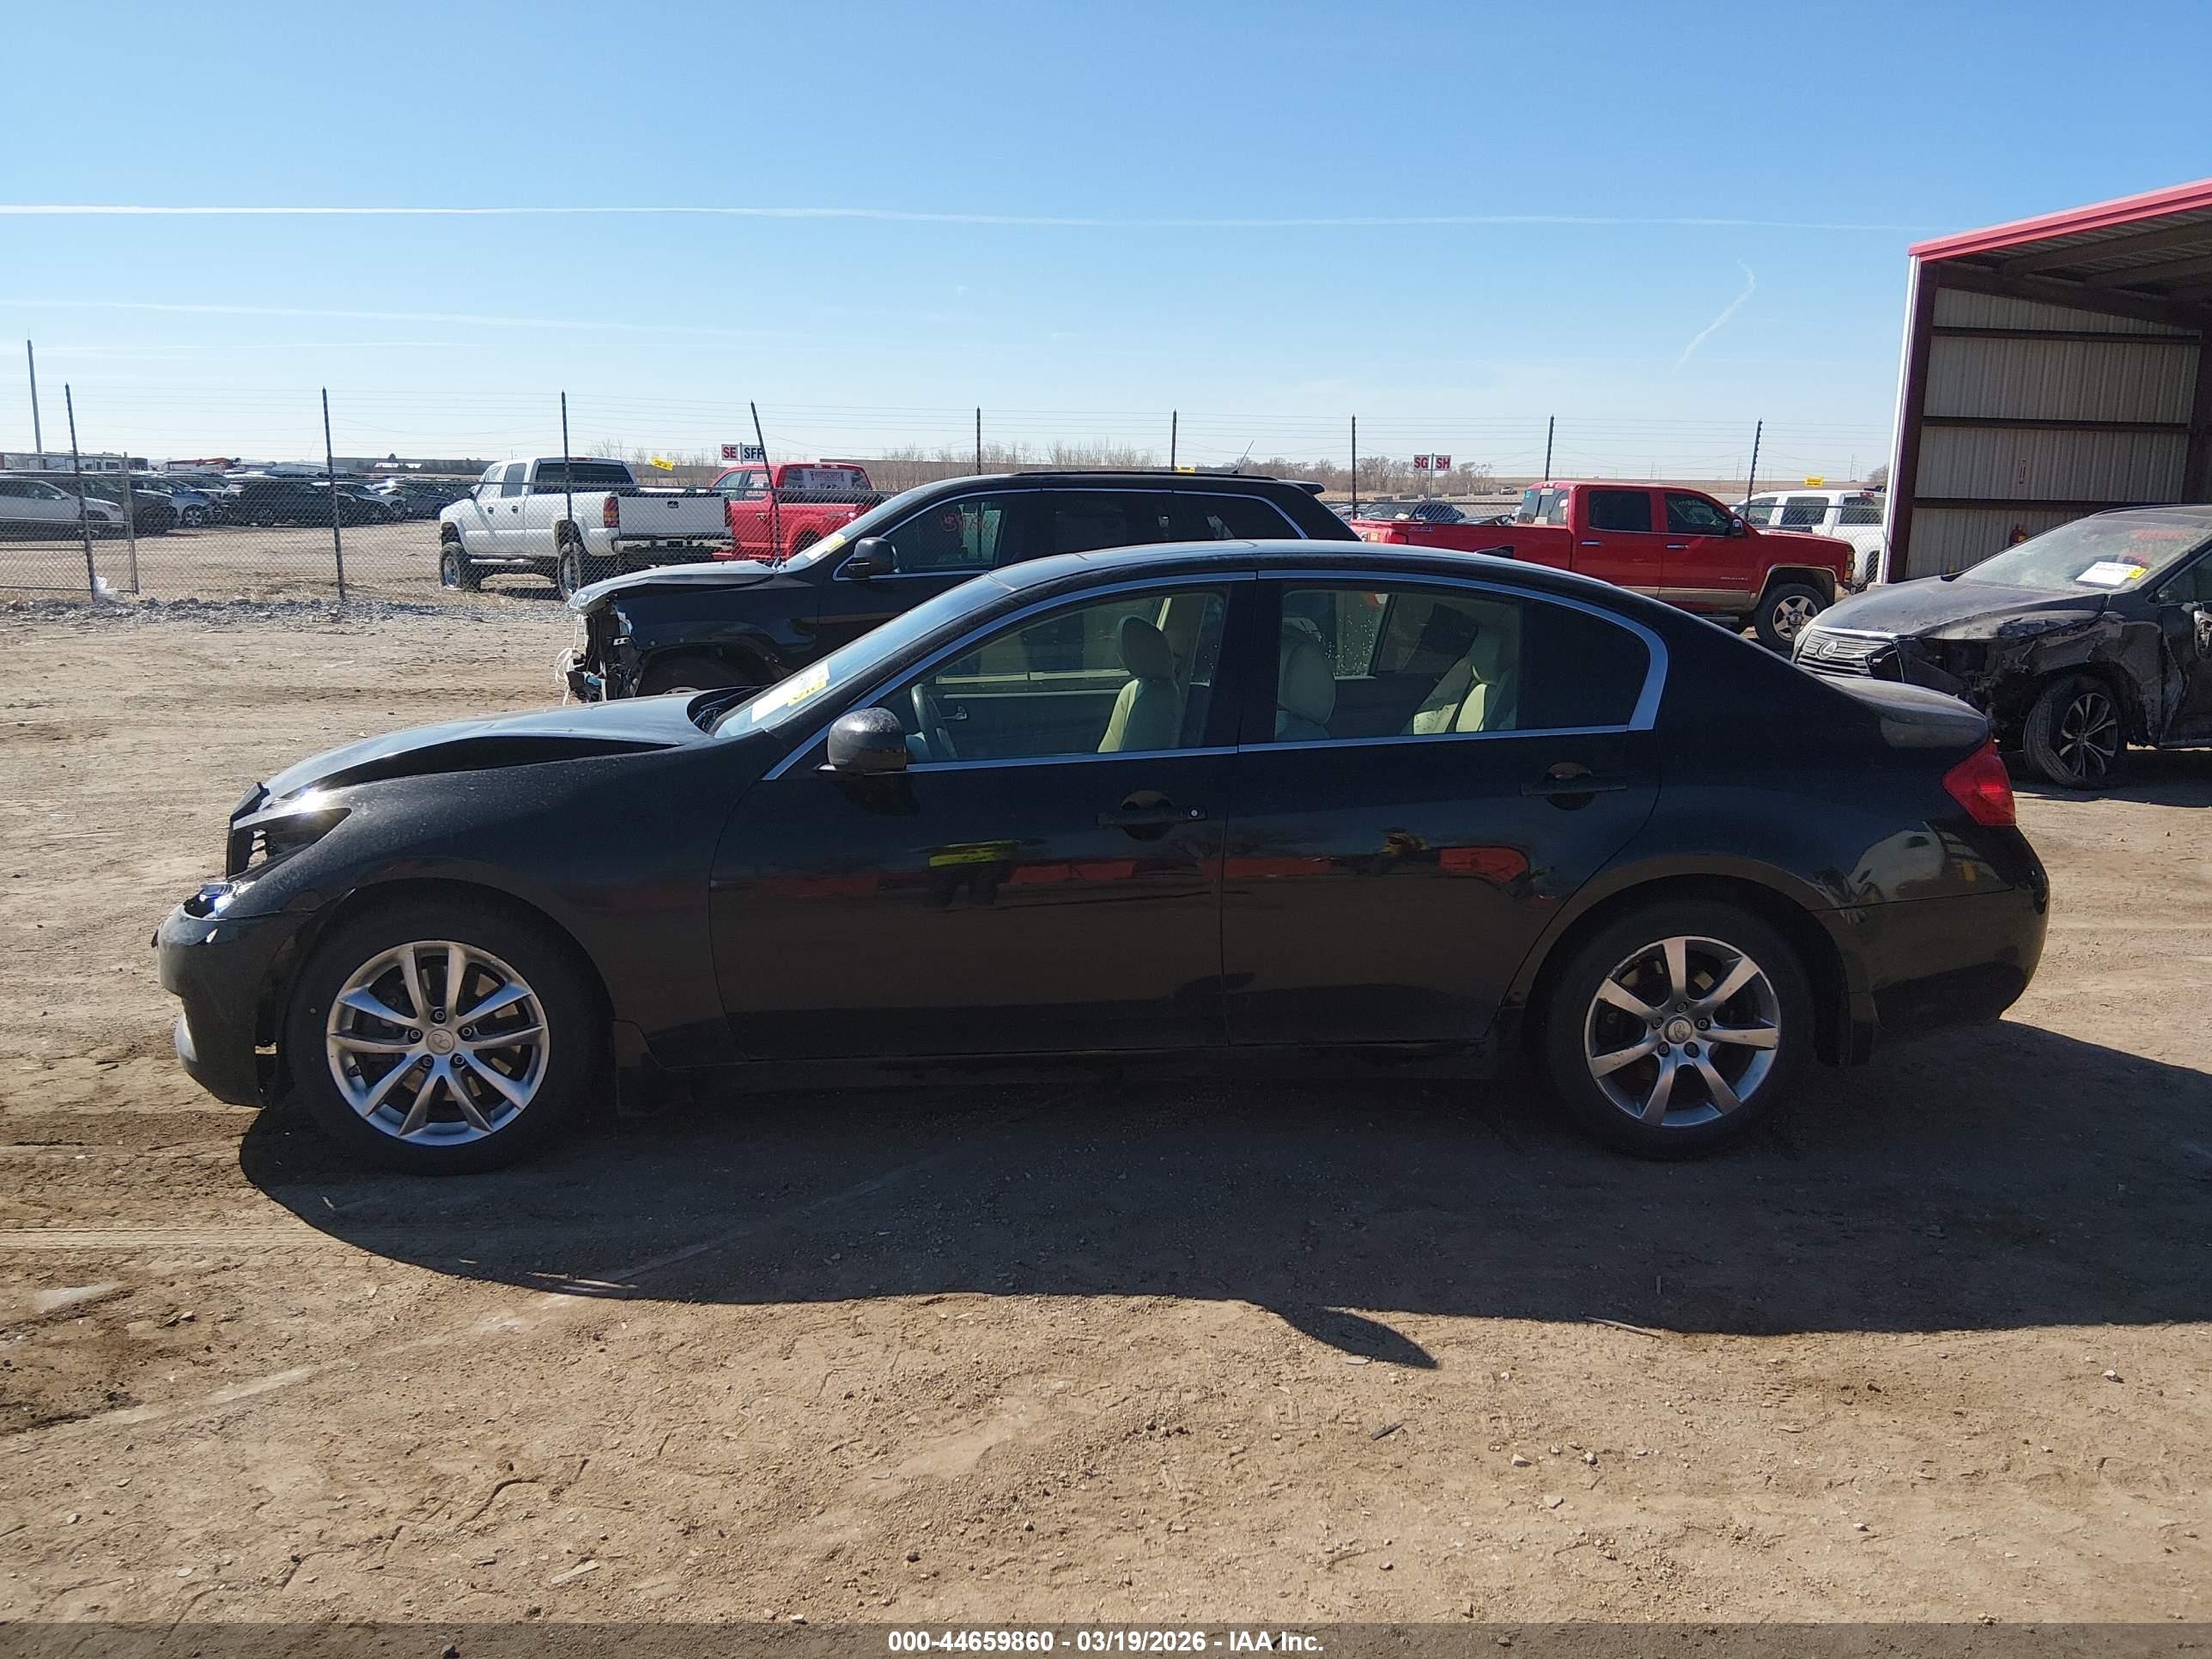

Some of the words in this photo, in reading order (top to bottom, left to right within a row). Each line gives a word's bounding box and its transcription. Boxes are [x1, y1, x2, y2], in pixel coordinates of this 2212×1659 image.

[723, 447, 737, 459] SE
[1414, 457, 1429, 469] SG
[1436, 457, 1450, 469] SH
